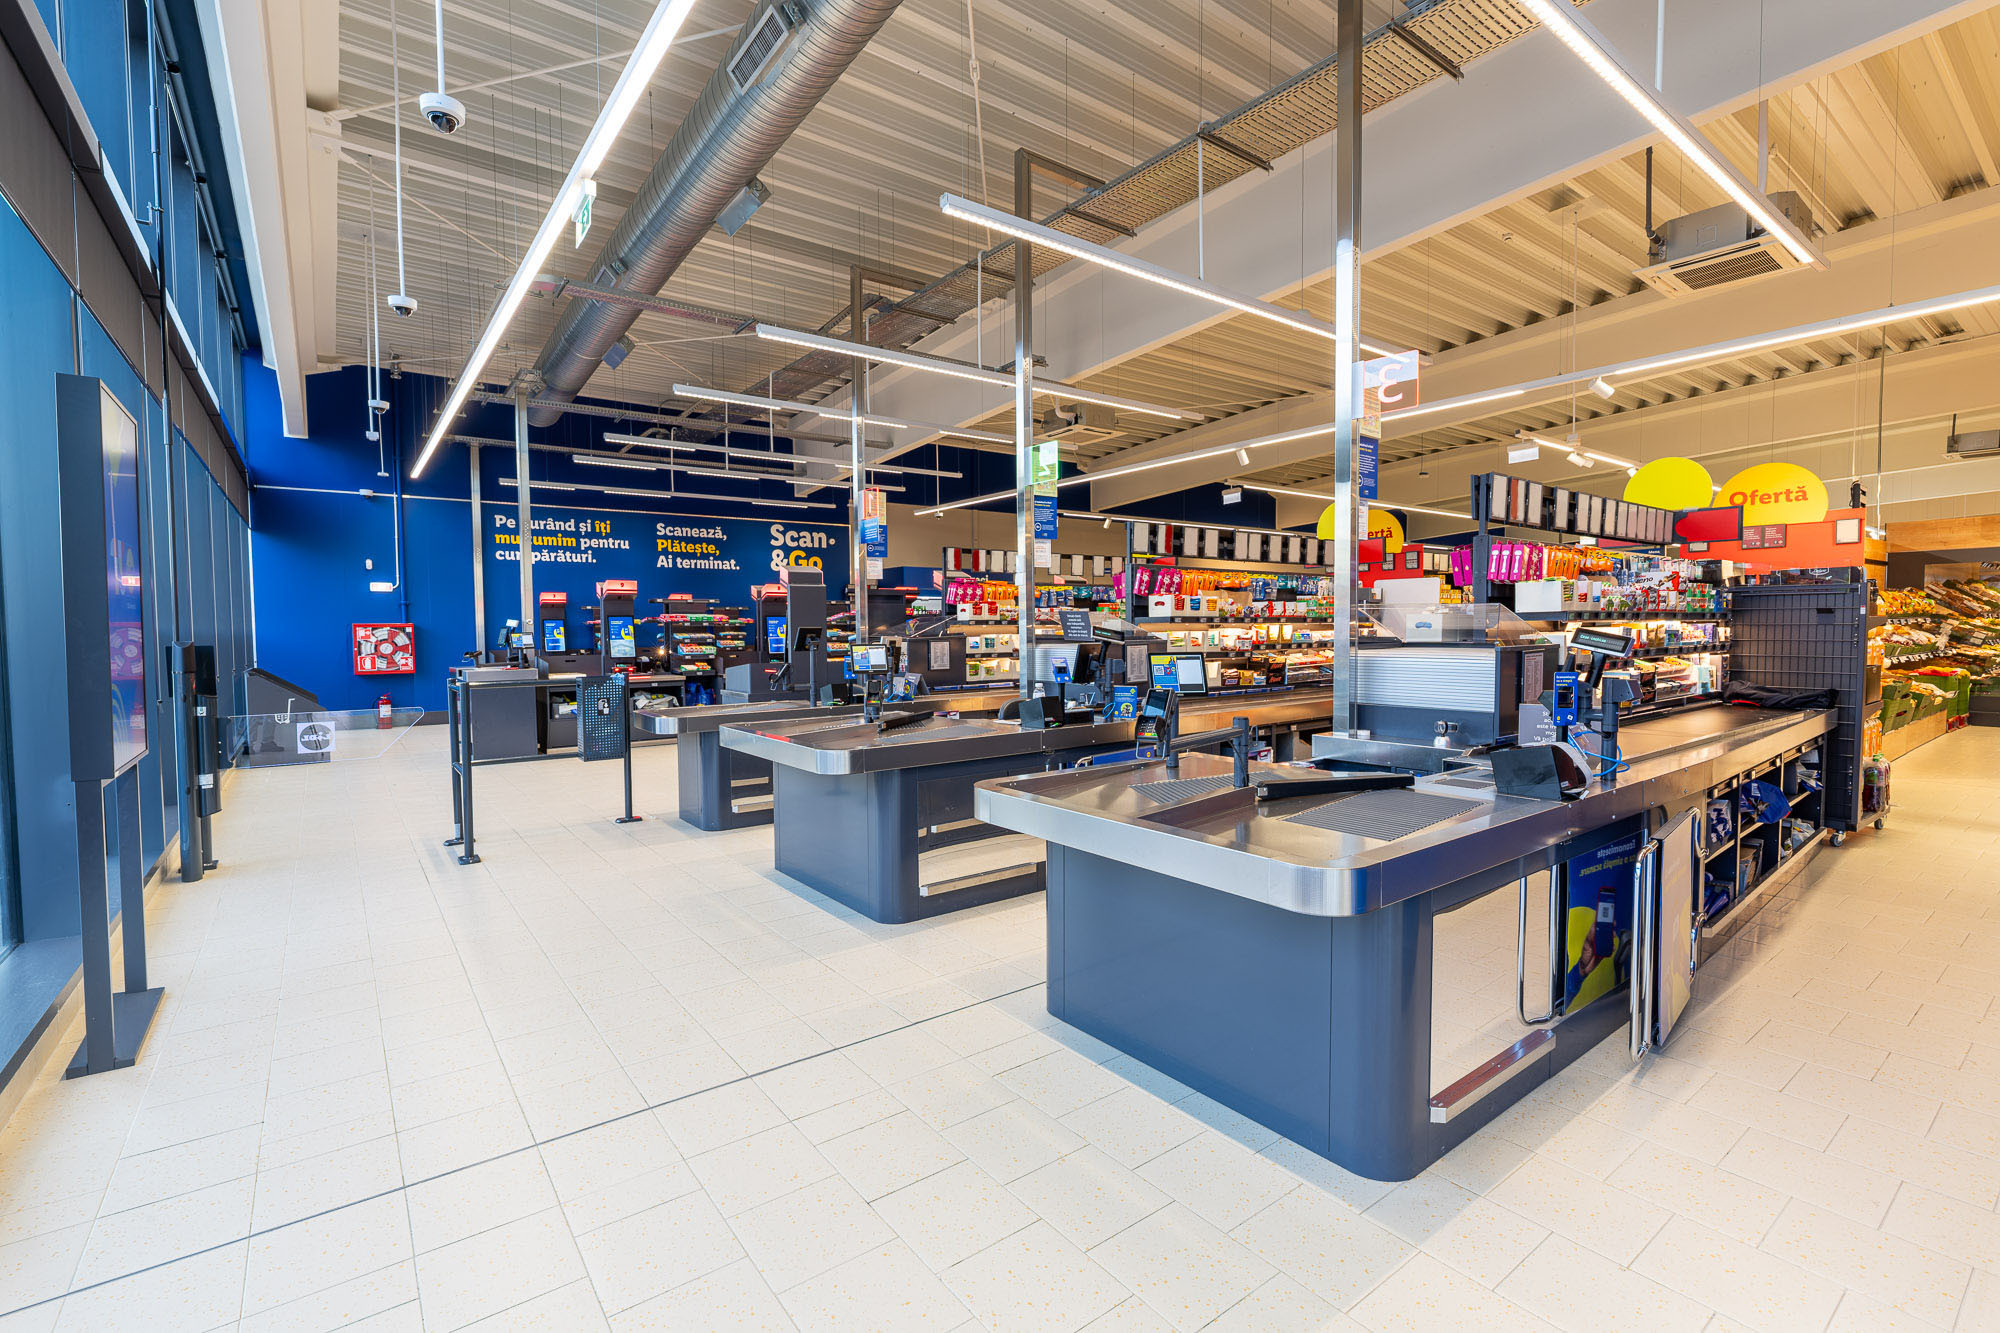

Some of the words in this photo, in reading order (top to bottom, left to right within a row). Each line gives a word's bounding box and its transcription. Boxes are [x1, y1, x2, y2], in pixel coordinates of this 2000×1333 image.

[1729, 485, 1809, 506] Ofertă
[495, 514, 516, 528] Pe
[530, 517, 576, 532] urând
[579, 519, 592, 535] și
[594, 520, 611, 537] îți
[656, 522, 728, 541] Scanează,
[494, 533, 577, 547] muumim
[580, 537, 630, 551] pentru
[656, 539, 720, 557] Plătește,
[495, 549, 597, 565] cupărături.
[656, 555, 673, 568] Ai
[676, 557, 740, 570] terminat.
